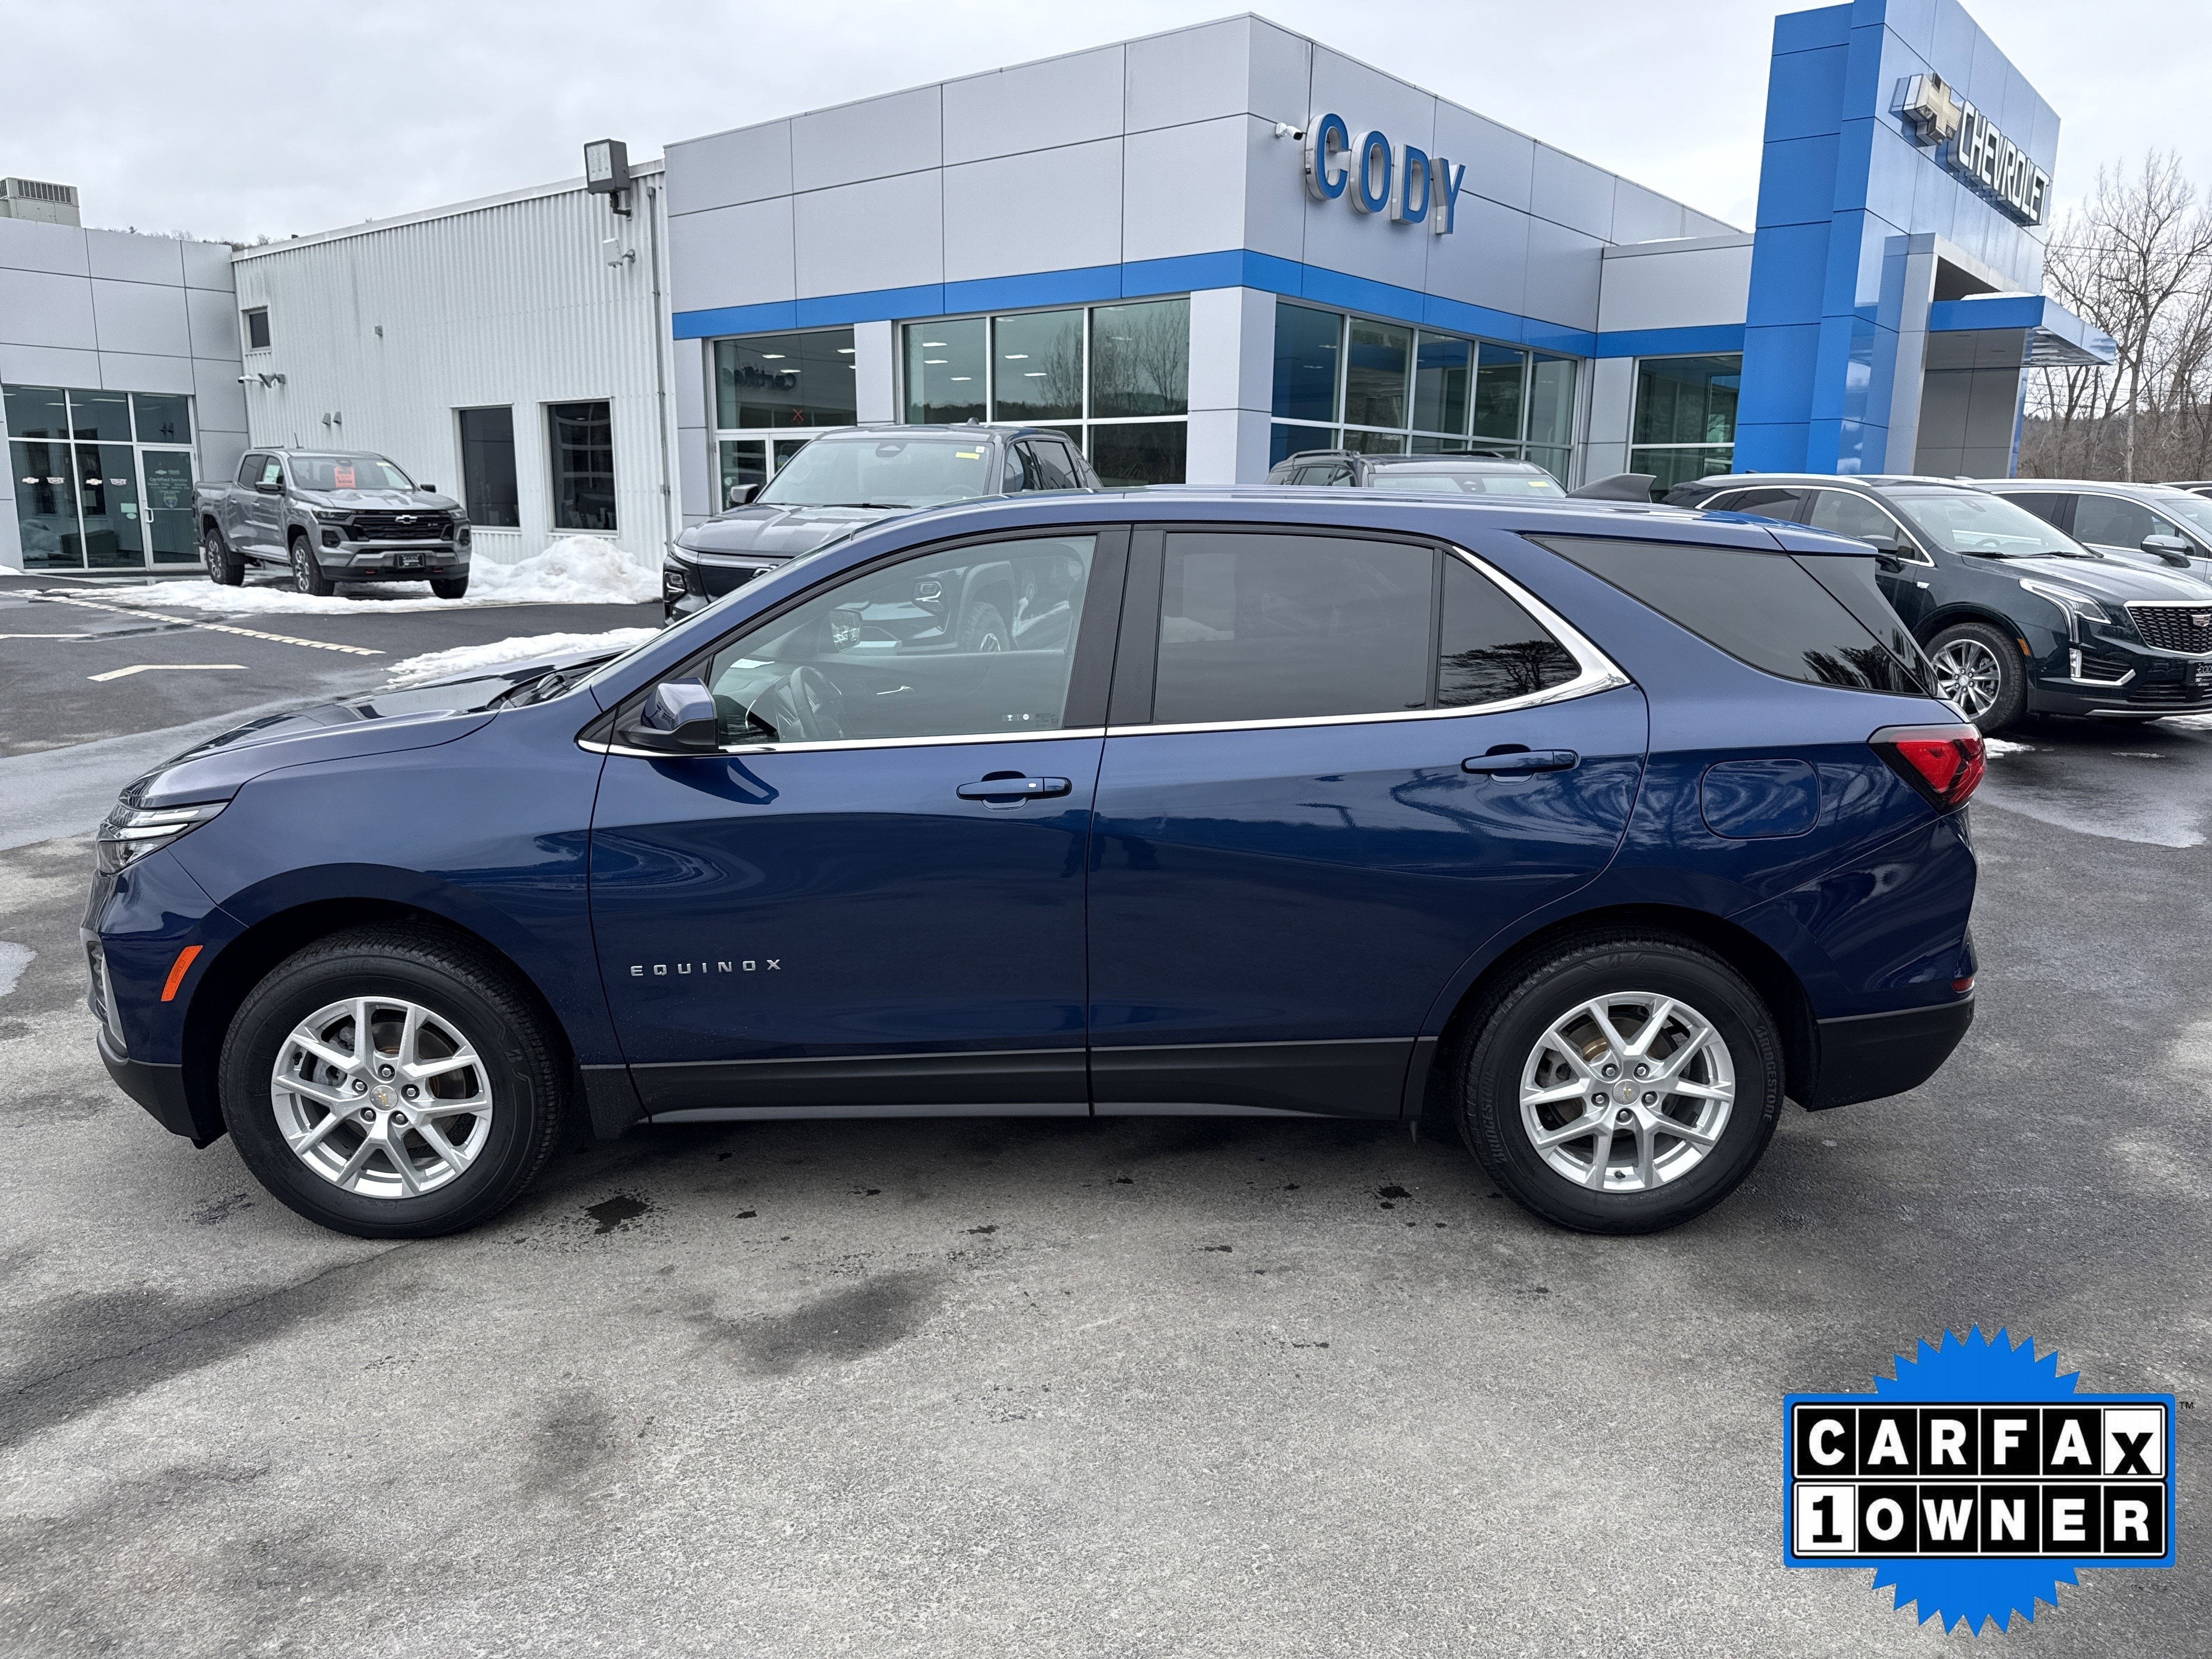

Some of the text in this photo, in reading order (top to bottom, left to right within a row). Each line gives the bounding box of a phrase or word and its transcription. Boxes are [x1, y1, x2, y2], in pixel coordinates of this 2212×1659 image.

[1306, 113, 1466, 235] CODY
[1948, 100, 2051, 225] CHEVROLET
[2198, 665, 2212, 673] COD
[631, 959, 781, 977] EQUINOX
[1754, 1025, 1778, 1123] BRIDGESTONE
